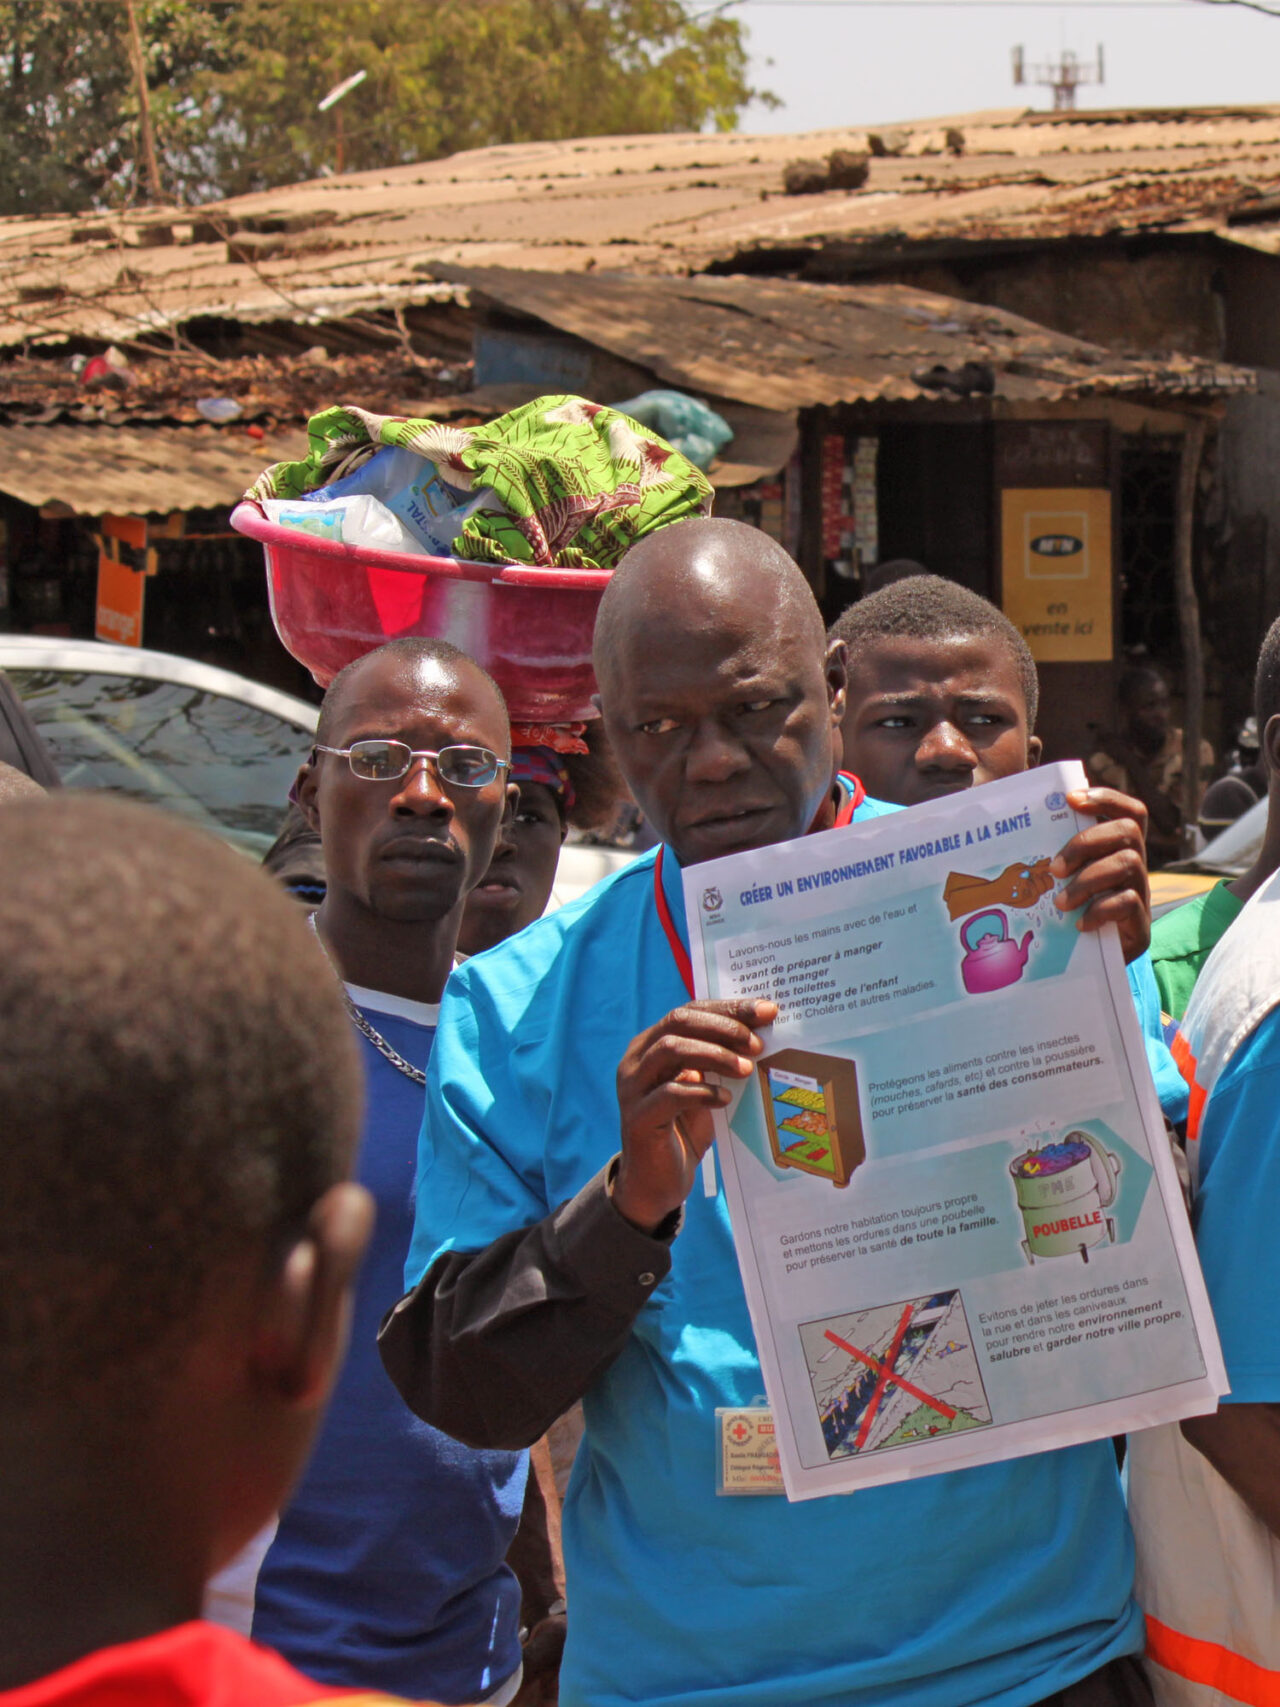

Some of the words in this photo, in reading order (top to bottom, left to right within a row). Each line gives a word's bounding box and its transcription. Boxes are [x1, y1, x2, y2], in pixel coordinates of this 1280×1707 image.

[1022, 621, 1072, 637] vente
[1074, 620, 1094, 636] ici
[1046, 602, 1068, 616] en
[737, 882, 773, 906] CRÉER
[775, 880, 794, 897] UN
[795, 853, 896, 892] ENVIRONNEMENT
[897, 834, 961, 865] FAVORABLE
[963, 830, 974, 846] A
[976, 825, 991, 842] LA
[992, 806, 1032, 836] SANTÉ
[728, 937, 792, 959] Lavons-nous
[794, 933, 810, 943] les
[811, 926, 841, 940] mains
[843, 919, 867, 932] avec
[868, 915, 881, 925] de
[883, 908, 906, 920] l'eau
[907, 903, 917, 914] et
[730, 961, 743, 972] du
[745, 954, 776, 968] savon
[738, 968, 769, 983] avant
[770, 964, 784, 975] de
[785, 954, 833, 974] préparer
[834, 951, 841, 960] à
[843, 941, 884, 958] manger
[740, 980, 769, 995] avant
[771, 977, 786, 987] de
[788, 968, 830, 984] manger
[773, 990, 790, 1000] les
[792, 980, 836, 996] toilettes
[787, 991, 843, 1009] nettoyage
[843, 987, 858, 997] de
[859, 976, 899, 993] l'enfant
[792, 1010, 803, 1021] le
[803, 1003, 845, 1019] Choléra
[847, 999, 858, 1010] et
[859, 992, 891, 1007] autres
[867, 1073, 926, 1094] Protégeons
[927, 1069, 941, 1079] les
[942, 1057, 983, 1075] aliments
[985, 1049, 1017, 1064] contre
[1019, 1045, 1035, 1055] les
[1036, 1034, 1080, 1051] insectes
[964, 1069, 983, 1083] etc)
[985, 1066, 996, 1077] et
[997, 1060, 1030, 1075] contre
[1032, 1056, 1042, 1066] la
[1044, 1044, 1096, 1065] poussière
[872, 1106, 895, 1121] pour
[897, 1095, 943, 1115] préserver
[944, 1092, 954, 1101] la
[956, 1083, 986, 1098] santé
[988, 1079, 1008, 1090] des
[1010, 1057, 1104, 1085] consommateurs.
[779, 1229, 822, 1246] Gardons
[823, 1223, 849, 1236] notre
[850, 1212, 899, 1229] habitation
[901, 1202, 942, 1218] toujours
[943, 1194, 978, 1210] propre
[783, 1248, 793, 1259] et
[794, 1240, 834, 1256] mettons
[835, 1237, 850, 1247] les
[852, 1227, 891, 1243] ordures
[892, 1221, 917, 1234] dans
[919, 1216, 938, 1228] une
[940, 1205, 985, 1224] poubelle
[1032, 1211, 1103, 1239] POUBELLE
[785, 1259, 807, 1274] pour
[809, 1249, 855, 1268] préserver
[857, 1246, 868, 1255] la
[869, 1238, 898, 1253] santé
[899, 1235, 913, 1246] de
[916, 1229, 944, 1242] toute
[946, 1225, 956, 1235] la
[958, 1216, 999, 1232] famille.
[1020, 1304, 1033, 1314] de
[1035, 1298, 1058, 1313] jeter
[1061, 1294, 1077, 1305] les
[1079, 1284, 1120, 1301] ordures
[1122, 1277, 1149, 1290] dans
[981, 1327, 992, 1336] la
[994, 1323, 1012, 1334] rue
[1013, 1319, 1025, 1329] et
[1026, 1314, 1053, 1326] dans
[1054, 1310, 1071, 1320] les
[1072, 1297, 1127, 1316] caniveaux
[985, 1337, 1009, 1352] pour
[1012, 1329, 1046, 1344] rendre
[1047, 1322, 1075, 1335] notre
[1077, 1300, 1163, 1328] environnement
[989, 1346, 1031, 1362] salubre
[1032, 1342, 1044, 1352] et
[1045, 1334, 1083, 1352] garder
[1084, 1327, 1115, 1340] notre
[1117, 1320, 1141, 1332] ville
